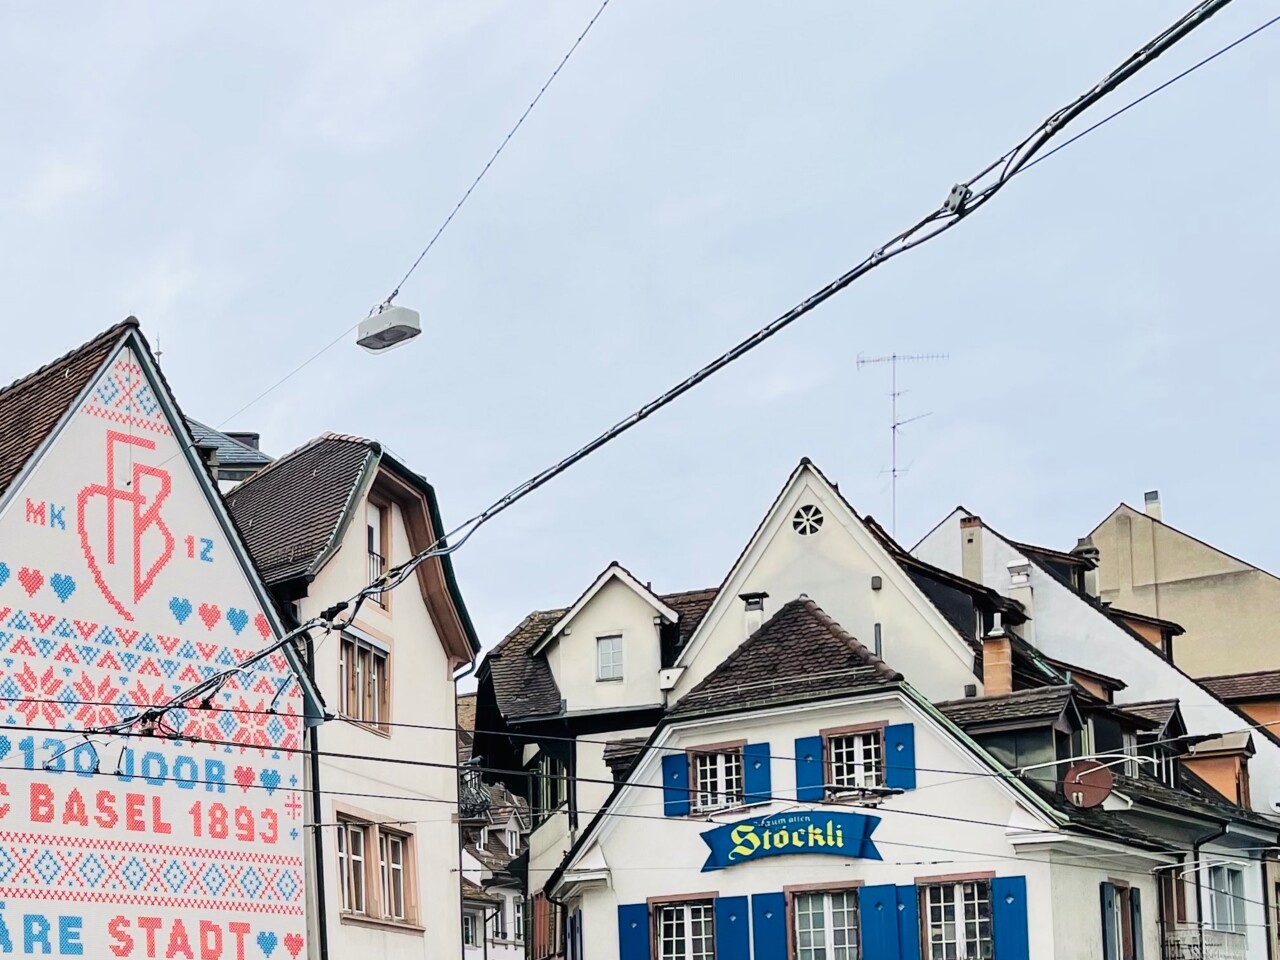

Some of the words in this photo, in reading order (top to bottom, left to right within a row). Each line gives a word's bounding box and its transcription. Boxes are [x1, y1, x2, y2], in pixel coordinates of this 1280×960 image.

[26, 497, 66, 531] MK
[19, 735, 98, 778] 130
[117, 748, 226, 793] JOOR
[30, 782, 172, 834] BASEL
[188, 800, 279, 844] 1893
[728, 819, 845, 861] Stöckli
